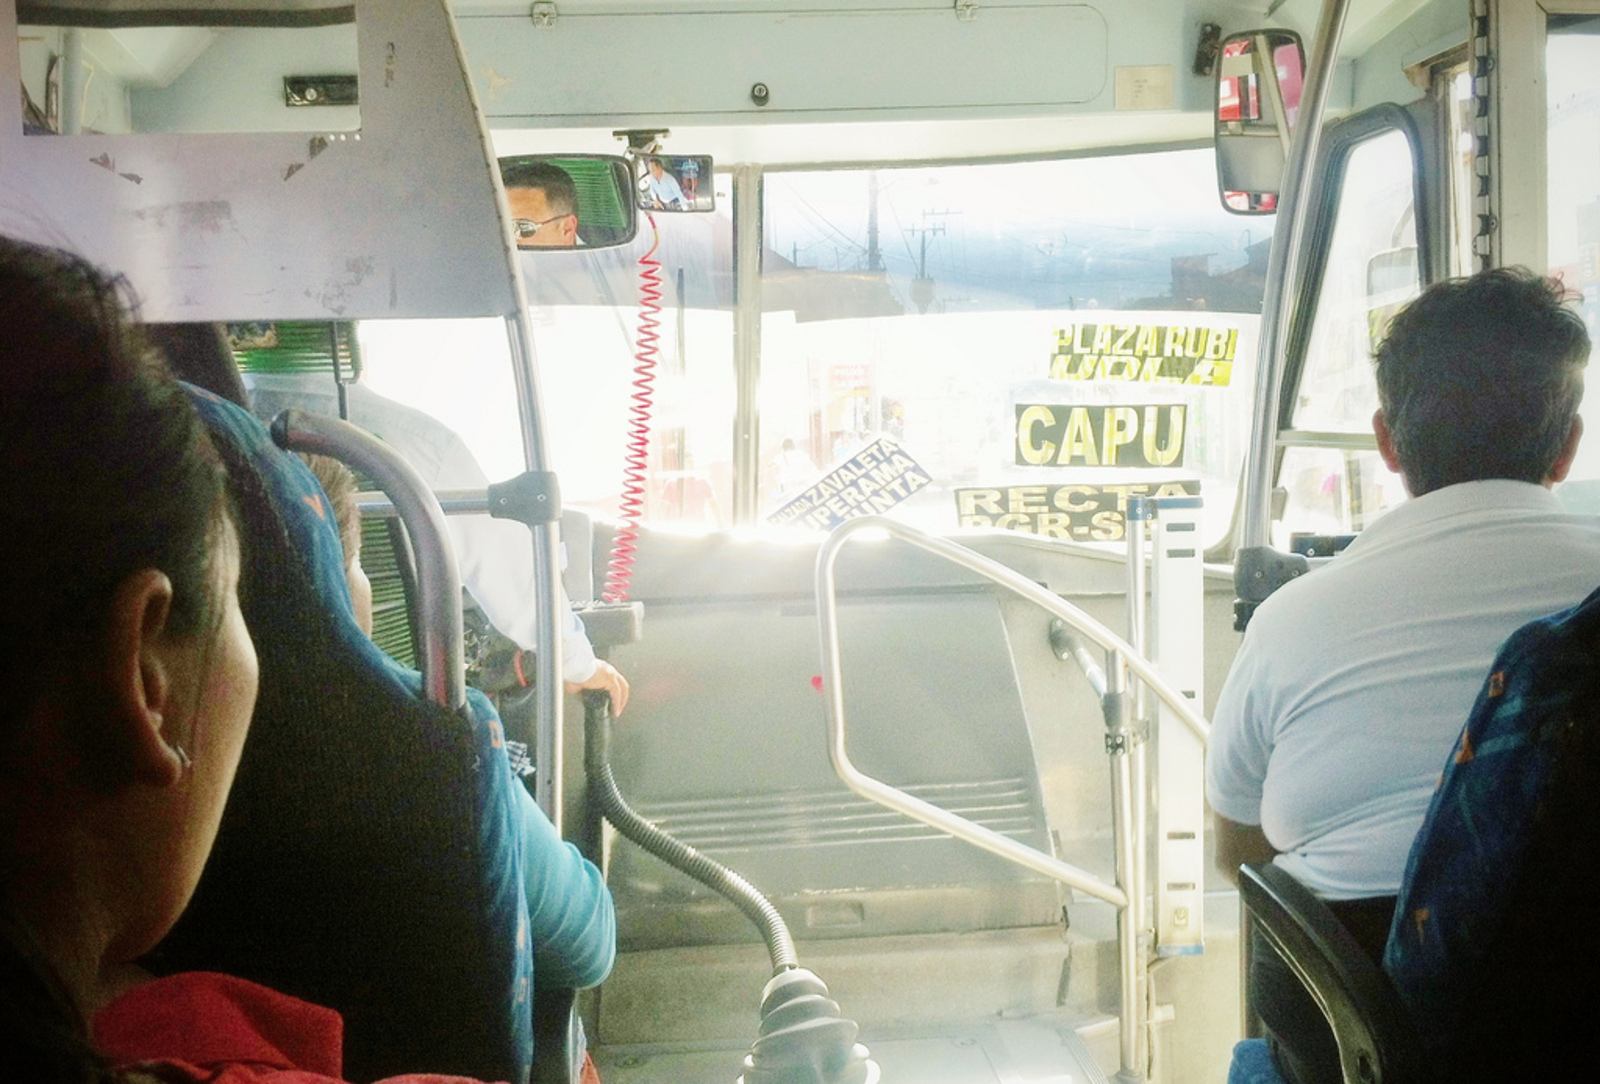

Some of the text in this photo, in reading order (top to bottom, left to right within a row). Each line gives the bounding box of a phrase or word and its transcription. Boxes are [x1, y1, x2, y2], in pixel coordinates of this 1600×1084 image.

[1052, 323, 1239, 361] PLAZA RUBI
[1018, 405, 1184, 466] CAPU
[806, 438, 898, 506] ZAVALETA
